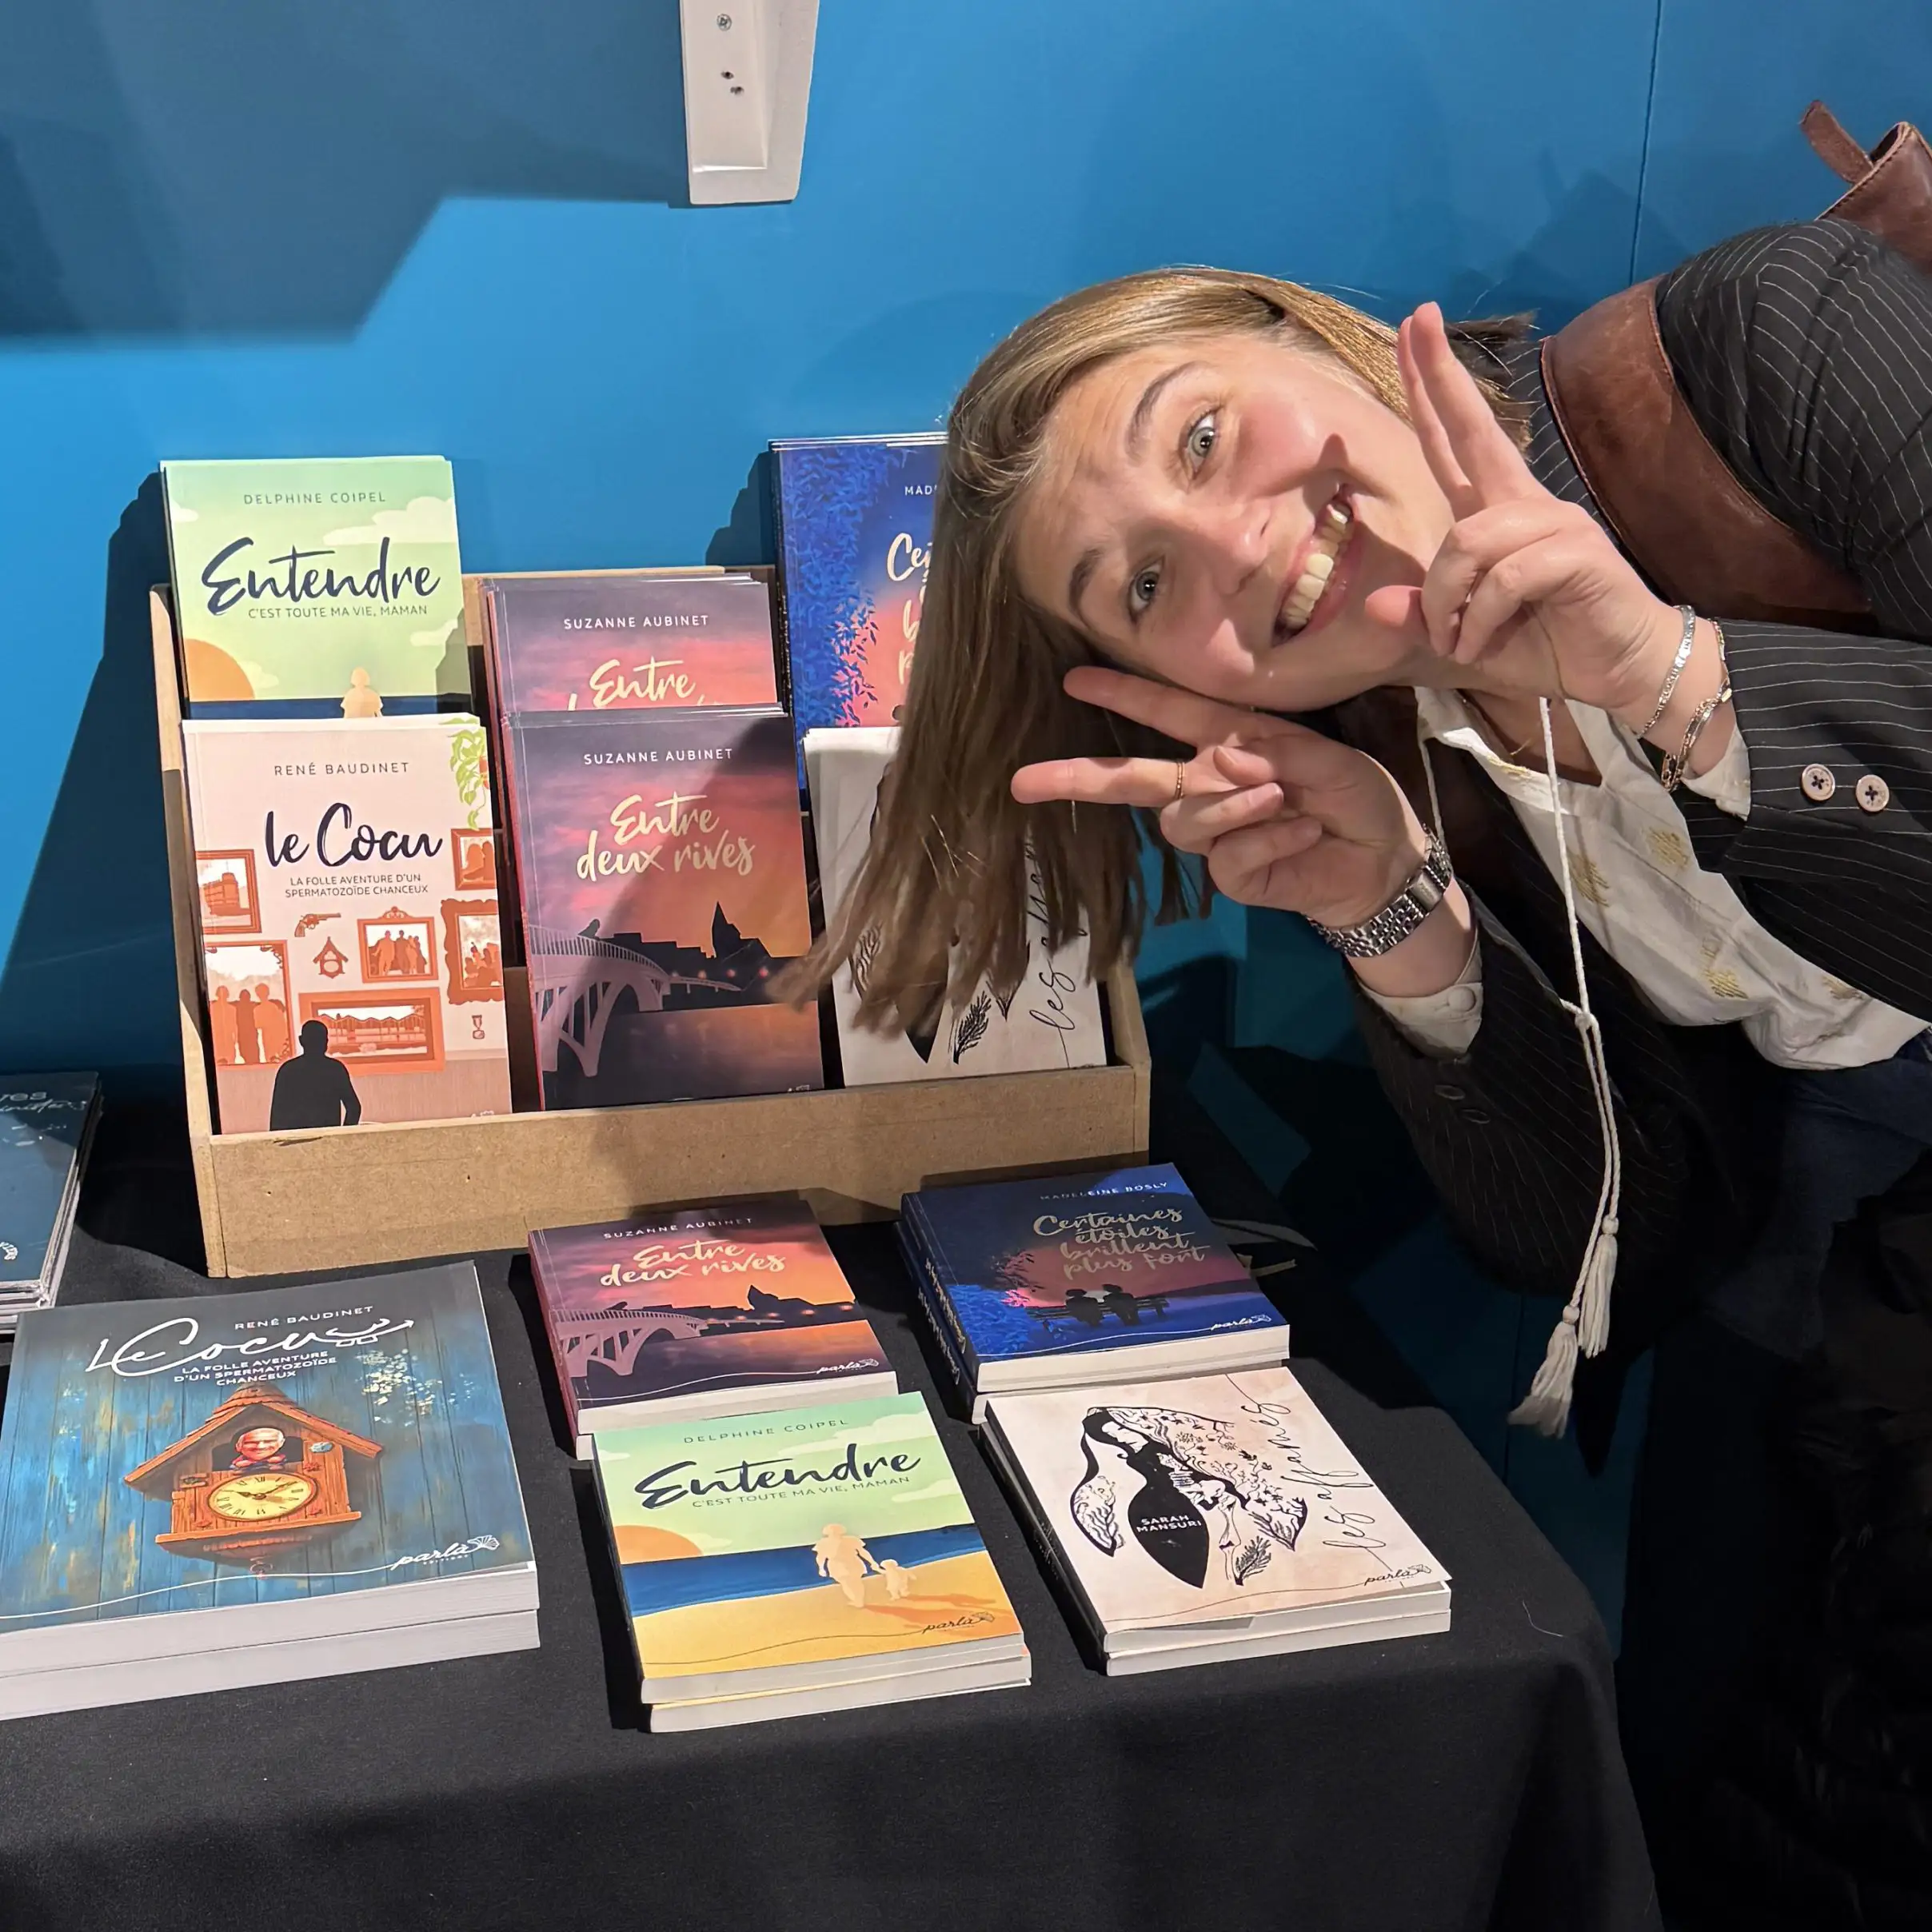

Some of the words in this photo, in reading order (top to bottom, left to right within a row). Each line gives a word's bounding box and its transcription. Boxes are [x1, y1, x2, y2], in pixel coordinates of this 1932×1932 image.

[243, 493, 323, 505] DELPHINE
[330, 491, 386, 504] COIPEL
[201, 537, 441, 616] Entendre
[248, 608, 281, 619] C'EST
[285, 607, 326, 618] TOUTE
[330, 606, 350, 617] MA
[353, 606, 377, 617] VIE,
[380, 605, 428, 617] MAMAN
[564, 617, 636, 629] SUZANNE
[643, 614, 709, 627] AUBINET
[589, 656, 696, 709] Entre
[273, 762, 317, 776] RENÉ
[325, 761, 410, 775] BAUDINET
[583, 752, 658, 765] SUZANNE
[665, 748, 733, 761] AUBINET
[610, 791, 720, 846] Entre
[265, 809, 309, 868] le
[317, 802, 443, 867] Cocu
[576, 830, 665, 882] deux
[674, 829, 755, 876] rives
[285, 885, 371, 898] SPERMATOZOÏDE
[373, 884, 429, 896] CHANCEUX
[290, 876, 304, 886] LA
[305, 876, 337, 886] FOLLE
[339, 874, 393, 884] AVENTURE
[396, 873, 421, 884] D'UN
[1029, 960, 1076, 1031] les
[1040, 1188, 1120, 1200] MADELEINE
[603, 1223, 678, 1239] SUZANNE
[685, 1216, 753, 1231] AUBINET
[1033, 1208, 1183, 1236] Certaines
[1075, 1223, 1169, 1244] étoiles
[633, 1239, 745, 1269] Entre
[1060, 1231, 1196, 1261] brillent
[600, 1263, 693, 1287] deux
[702, 1251, 786, 1277] rives
[1064, 1256, 1133, 1280] plus
[234, 1317, 280, 1330] RENÉ
[287, 1306, 374, 1324] BAUDINET
[174, 1372, 210, 1383] D'UN
[214, 1356, 337, 1379] SPERMATOZOÏDE
[182, 1365, 201, 1374] LA
[204, 1359, 249, 1373] FOLLE
[253, 1351, 329, 1366] AVENTURE
[216, 1370, 297, 1386] CHANCEUX
[684, 1427, 776, 1443] DELPHINE
[784, 1419, 850, 1433] COIPEL
[634, 1443, 921, 1511] Entendre
[692, 1496, 732, 1509] C'EST
[736, 1491, 788, 1503] TOUTE
[792, 1487, 816, 1498] MA
[817, 1484, 848, 1495] VIE,
[852, 1476, 910, 1491] MAMAN
[1136, 1520, 1202, 1532] MANSURI
[1140, 1515, 1190, 1526] SARAH
